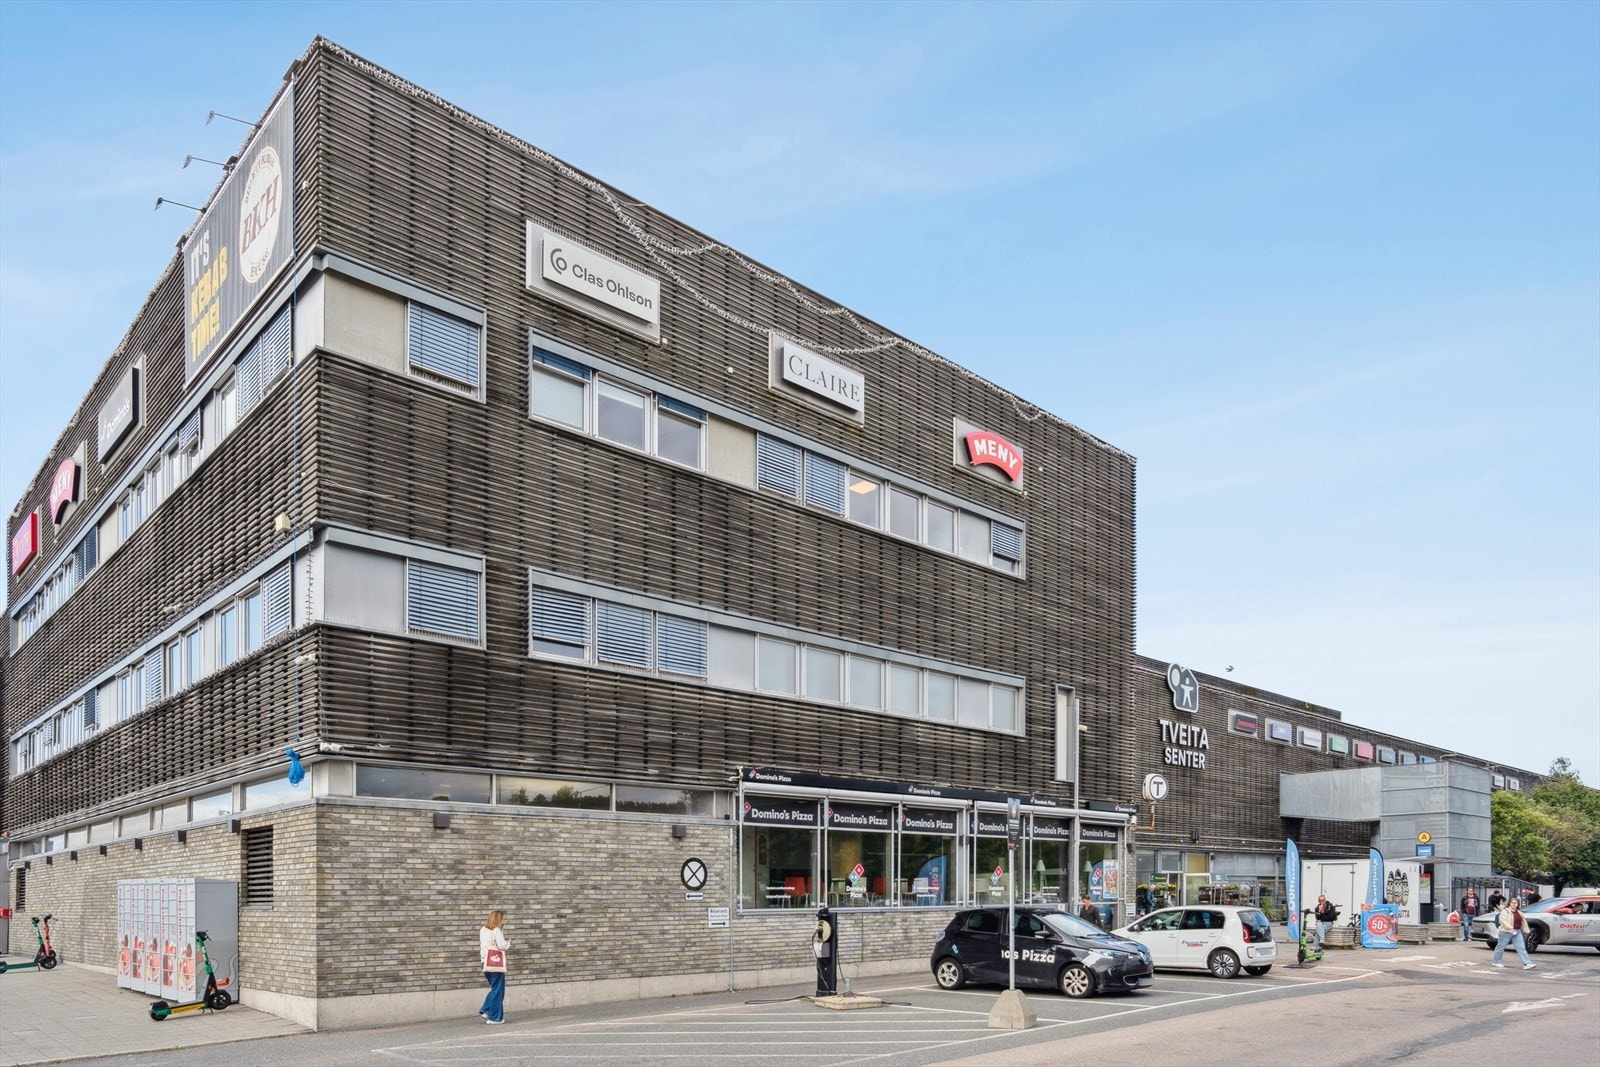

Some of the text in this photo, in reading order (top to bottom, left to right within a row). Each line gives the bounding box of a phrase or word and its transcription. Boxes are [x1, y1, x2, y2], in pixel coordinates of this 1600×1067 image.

[241, 174, 280, 255] BKH
[191, 229, 210, 285] IT'S
[191, 246, 228, 324] KEBAB
[572, 264, 604, 288] Clas
[606, 279, 652, 309] Ohlson
[191, 297, 220, 362] TIME!
[788, 354, 861, 403] CLAIRE
[106, 398, 130, 439] Domino's
[973, 438, 1018, 470] MENY
[52, 468, 73, 509] MENY
[1160, 719, 1209, 750] TVEITA
[1164, 747, 1206, 769] SENTER
[755, 773, 778, 781] Domino's
[1153, 780, 1163, 797] T
[751, 808, 814, 821] Domino's Pizza
[834, 814, 888, 826] Domino's Pizza
[905, 818, 953, 829] Domino's Pizza
[979, 822, 1005, 832] Domino's
[1033, 825, 1057, 835] Domino's
[1082, 828, 1116, 838] Domino's Pizza
[1022, 949, 1055, 963] Pizza
